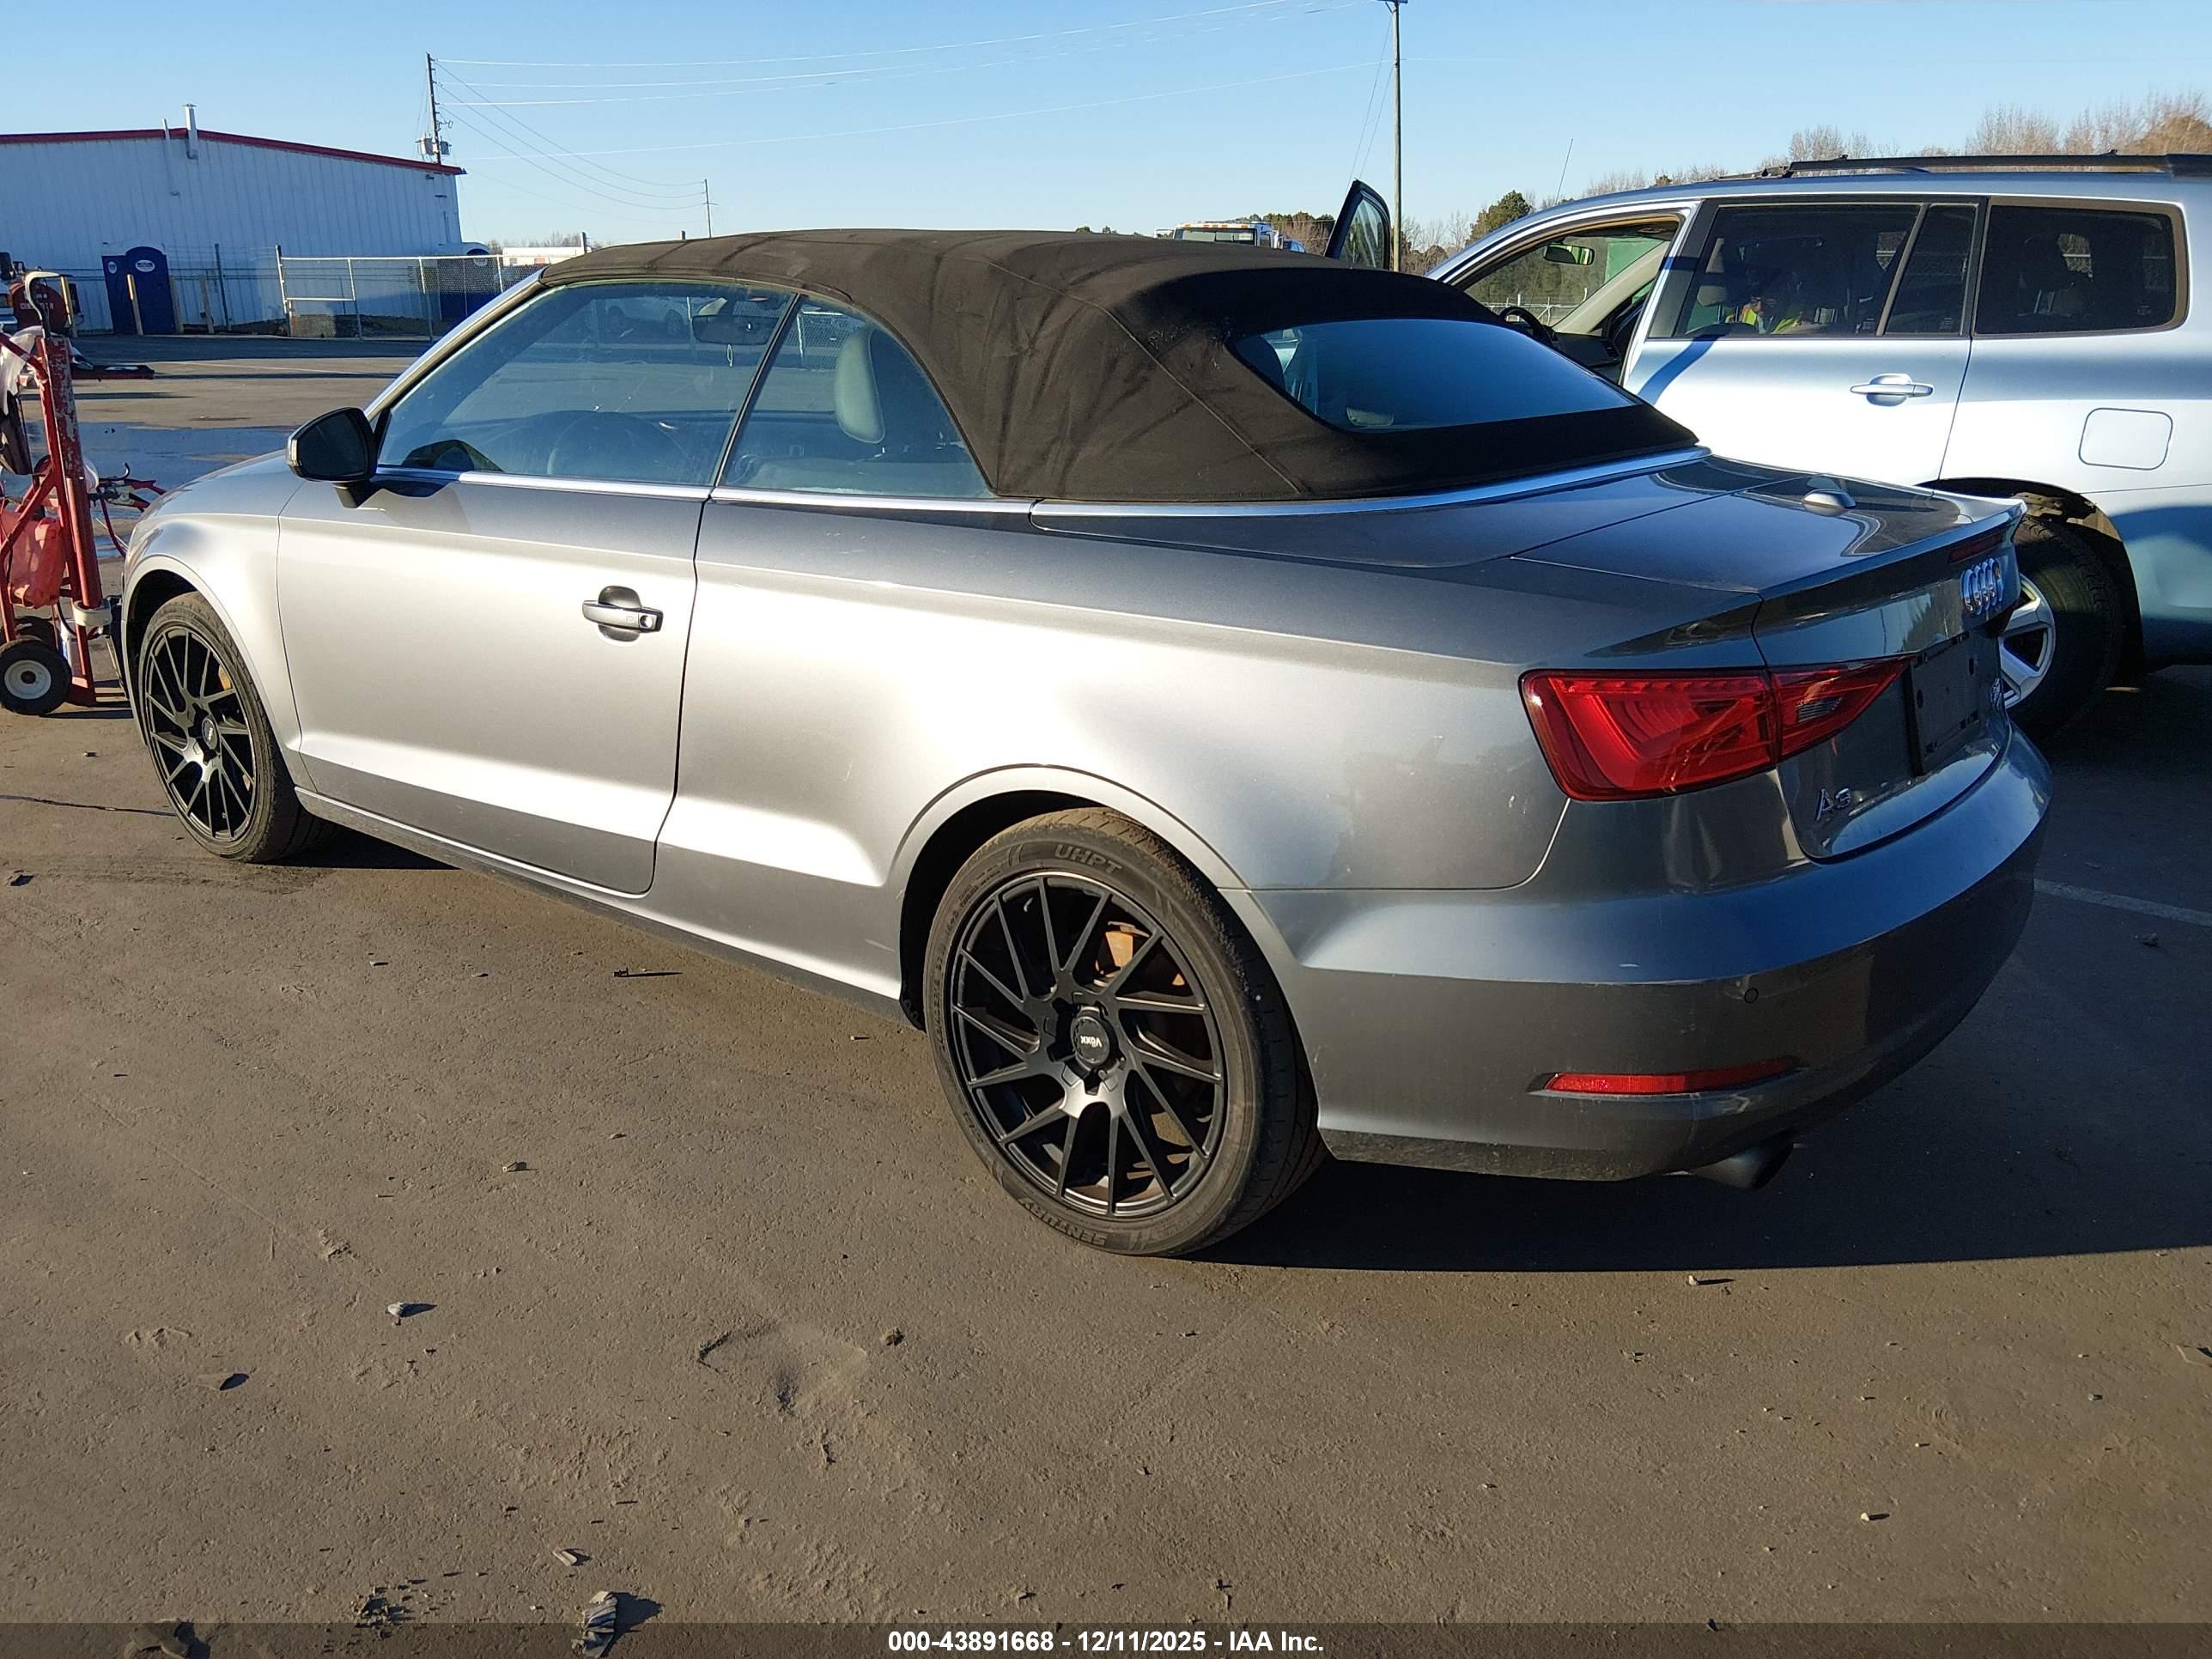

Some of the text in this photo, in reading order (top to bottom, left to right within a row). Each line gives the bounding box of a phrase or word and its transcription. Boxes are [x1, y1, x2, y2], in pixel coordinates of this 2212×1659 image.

[1815, 787, 1851, 821] A3
[1054, 844, 1122, 874] UHPT
[1017, 1197, 1108, 1248] SENTURY
